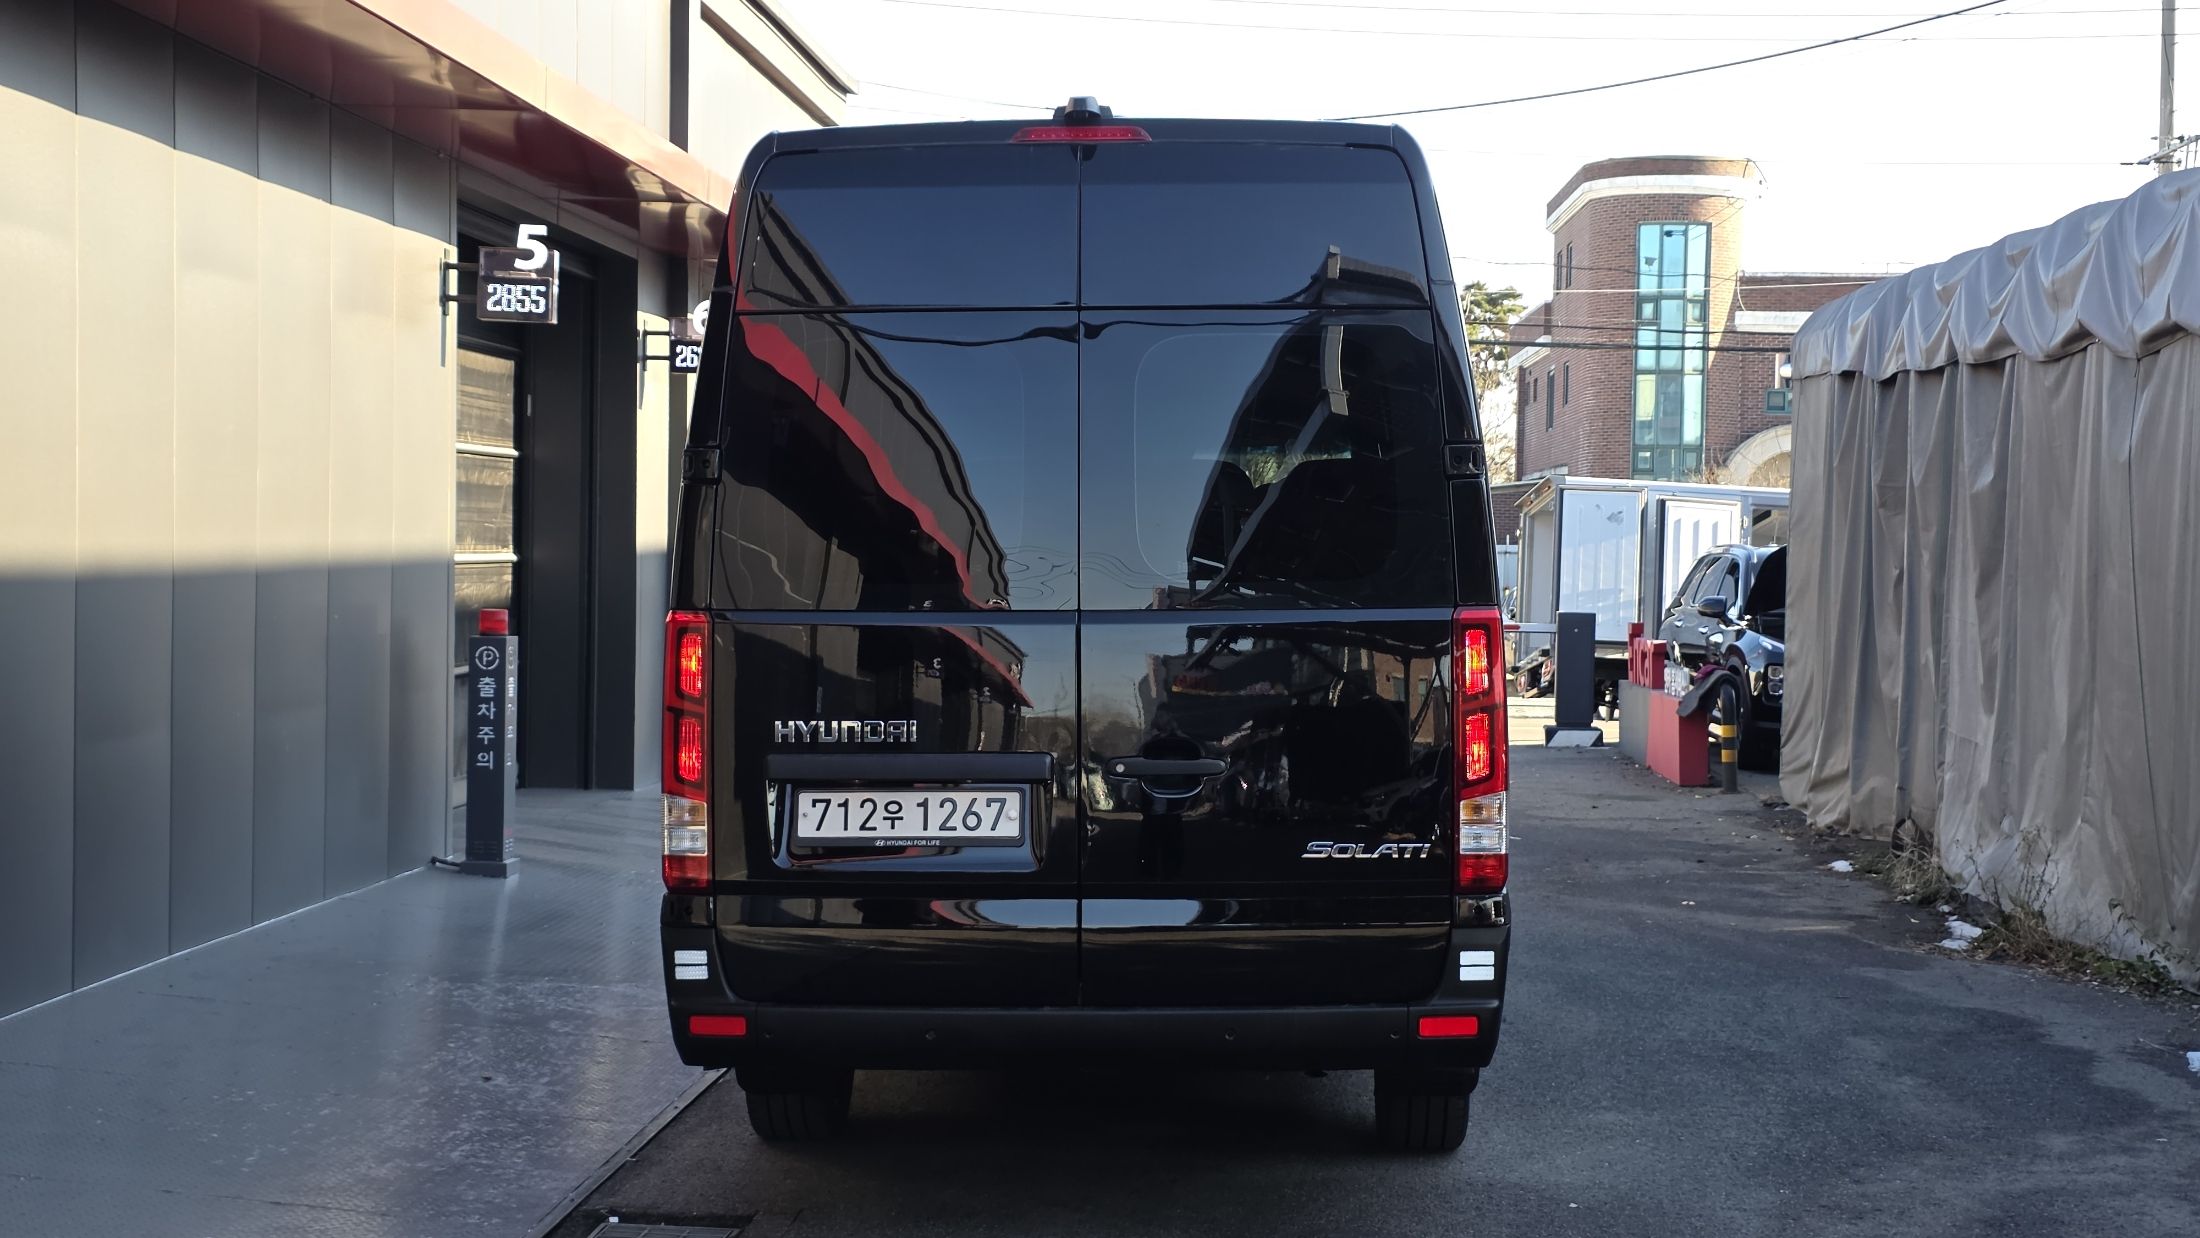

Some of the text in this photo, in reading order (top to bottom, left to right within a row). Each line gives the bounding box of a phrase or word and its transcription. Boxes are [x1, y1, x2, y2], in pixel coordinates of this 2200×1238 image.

[513, 223, 548, 270] 5
[486, 284, 547, 313] 2855
[692, 299, 710, 335] 6
[675, 345, 702, 368] 26
[774, 720, 917, 742] HYUNDAI
[811, 797, 1007, 831] 712우 1267
[1301, 841, 1432, 859] SOLATI
